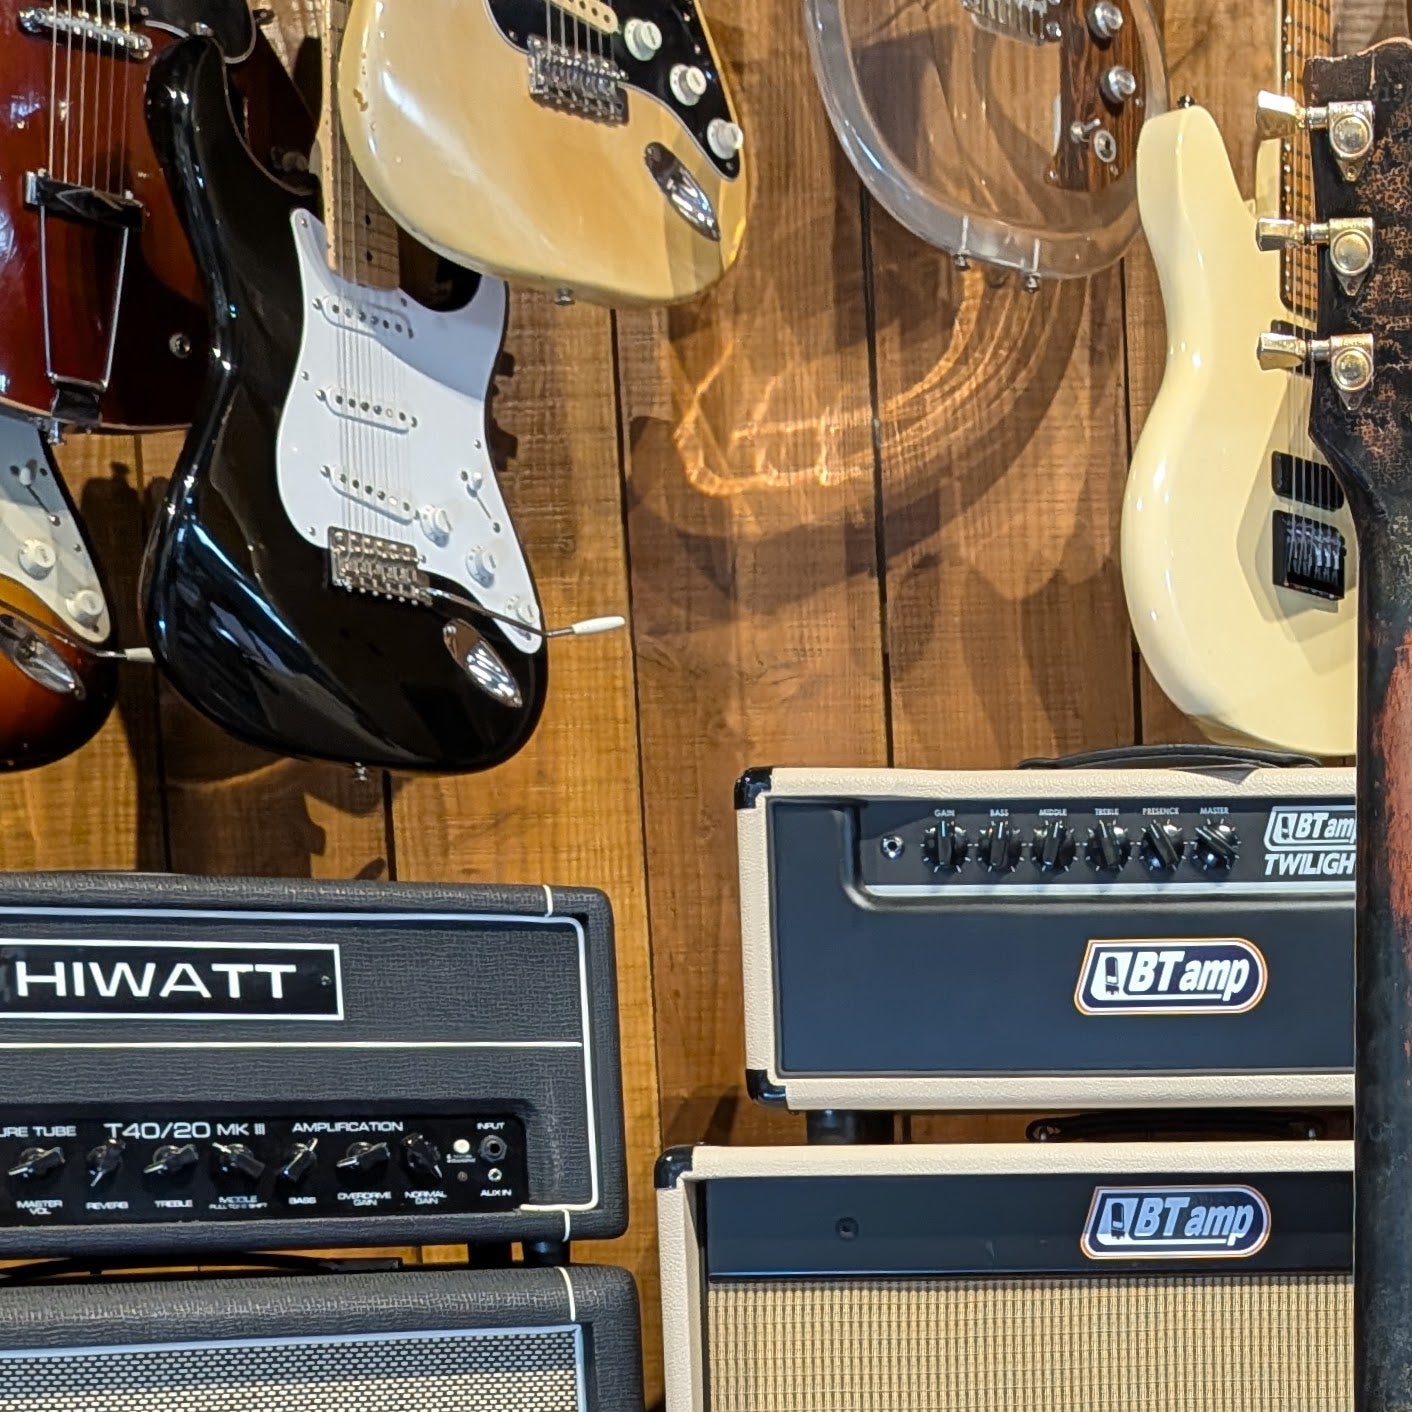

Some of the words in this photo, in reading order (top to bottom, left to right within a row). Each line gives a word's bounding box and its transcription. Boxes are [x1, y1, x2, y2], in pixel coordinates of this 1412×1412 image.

[934, 809, 955, 817] GAIN
[990, 808, 1009, 817] BASS
[1039, 808, 1067, 817] MIDDLE
[1095, 808, 1119, 816] TREBLE
[1142, 807, 1179, 815] PRESENCE
[1200, 807, 1229, 815] MASTER
[1264, 852, 1357, 875] TWILIGH
[15, 961, 297, 999] HIWATT
[103, 1121, 211, 1140] T40/20
[216, 1123, 250, 1137] MK
[292, 1121, 404, 1133] AMPLIFICATION
[477, 1122, 505, 1130] INPUT
[0, 1126, 29, 1138] URE
[32, 1125, 77, 1137] TUBE
[337, 1190, 392, 1200] OVERDRIVE
[404, 1190, 447, 1199] NORMAL
[480, 1188, 502, 1197] AUX
[501, 1188, 512, 1197] IN
[17, 1199, 63, 1209] MASTER
[154, 1199, 194, 1208] TREBLE
[288, 1196, 317, 1205] BASS
[353, 1199, 378, 1207] GAIN
[414, 1197, 438, 1205] GAIN
[86, 1201, 129, 1210] REVERB
